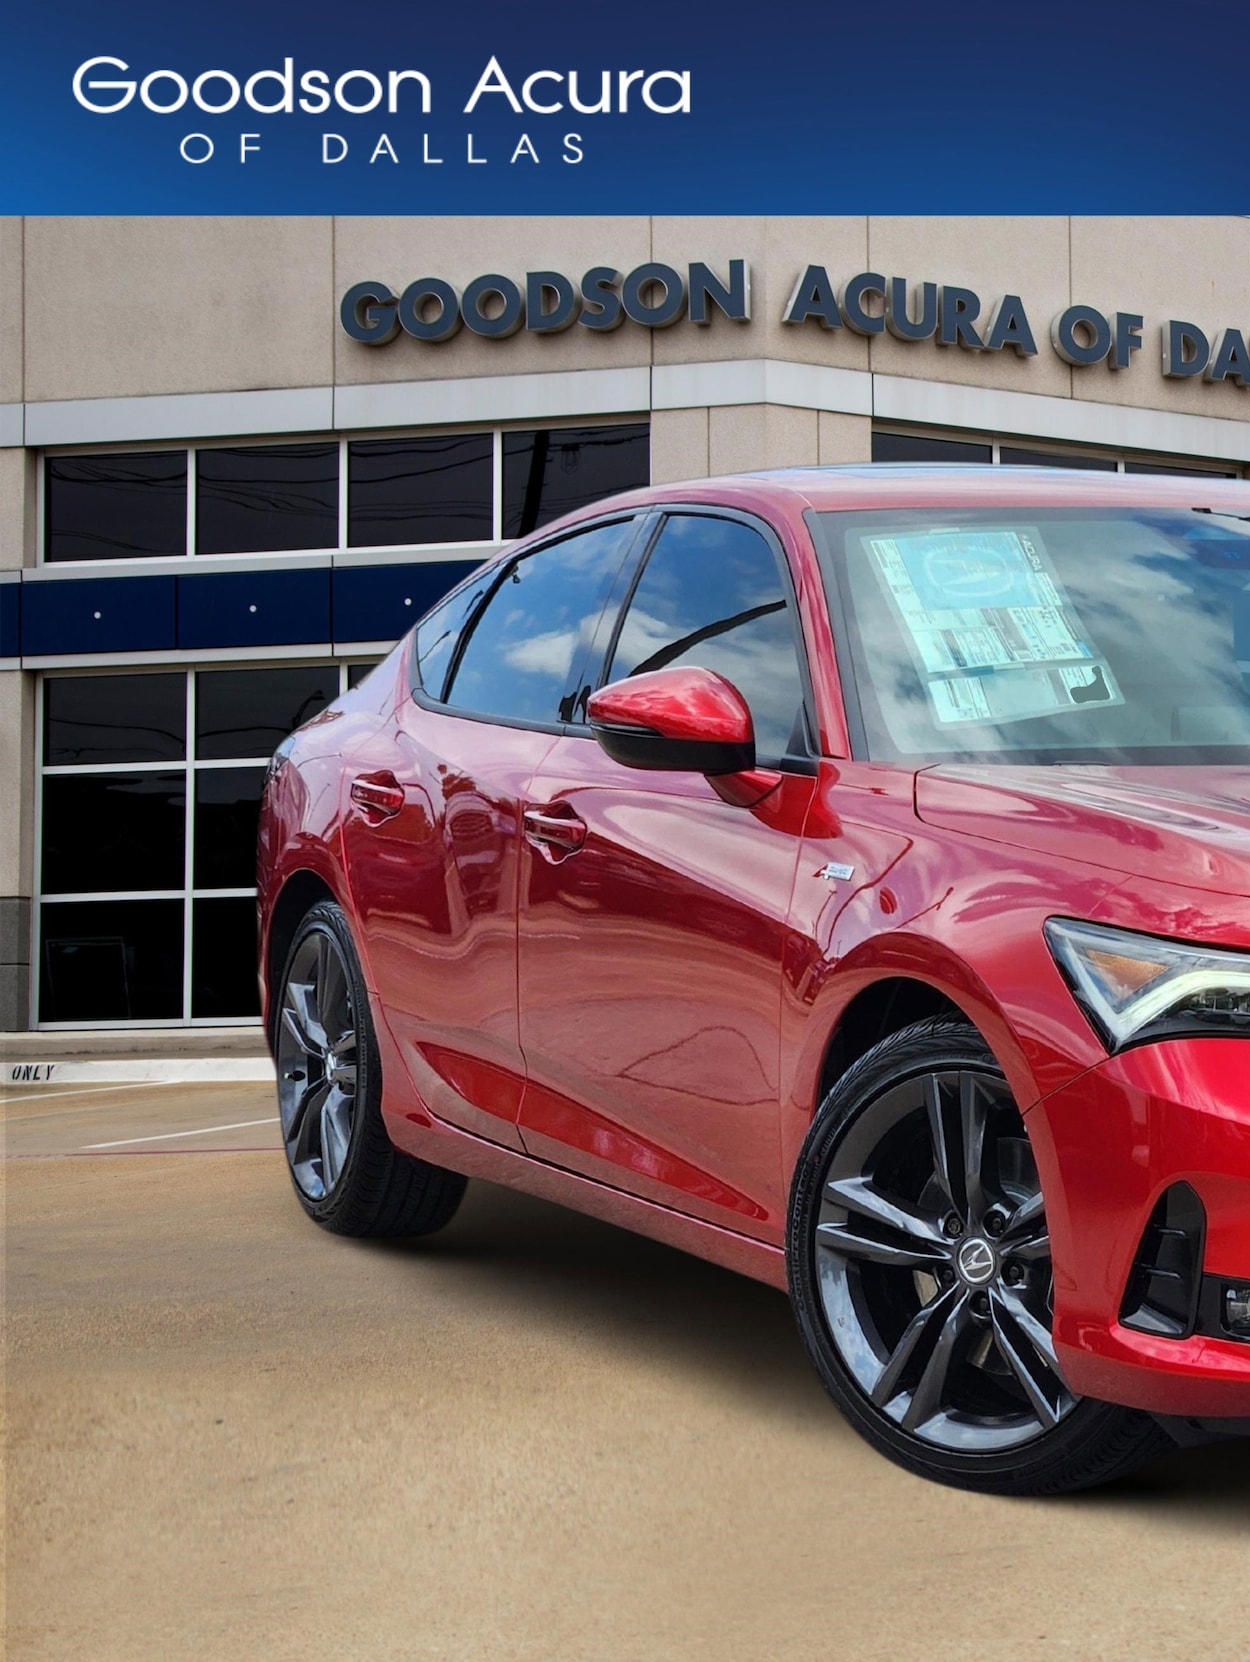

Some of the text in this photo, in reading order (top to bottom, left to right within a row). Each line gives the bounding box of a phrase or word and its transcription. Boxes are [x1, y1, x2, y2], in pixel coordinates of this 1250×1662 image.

[340, 259, 750, 343] GOODSON
[782, 264, 1038, 357] ACURA
[1051, 305, 1144, 369] OF
[1022, 540, 1042, 571] ACURA
[12, 1065, 55, 1080] ONLY
